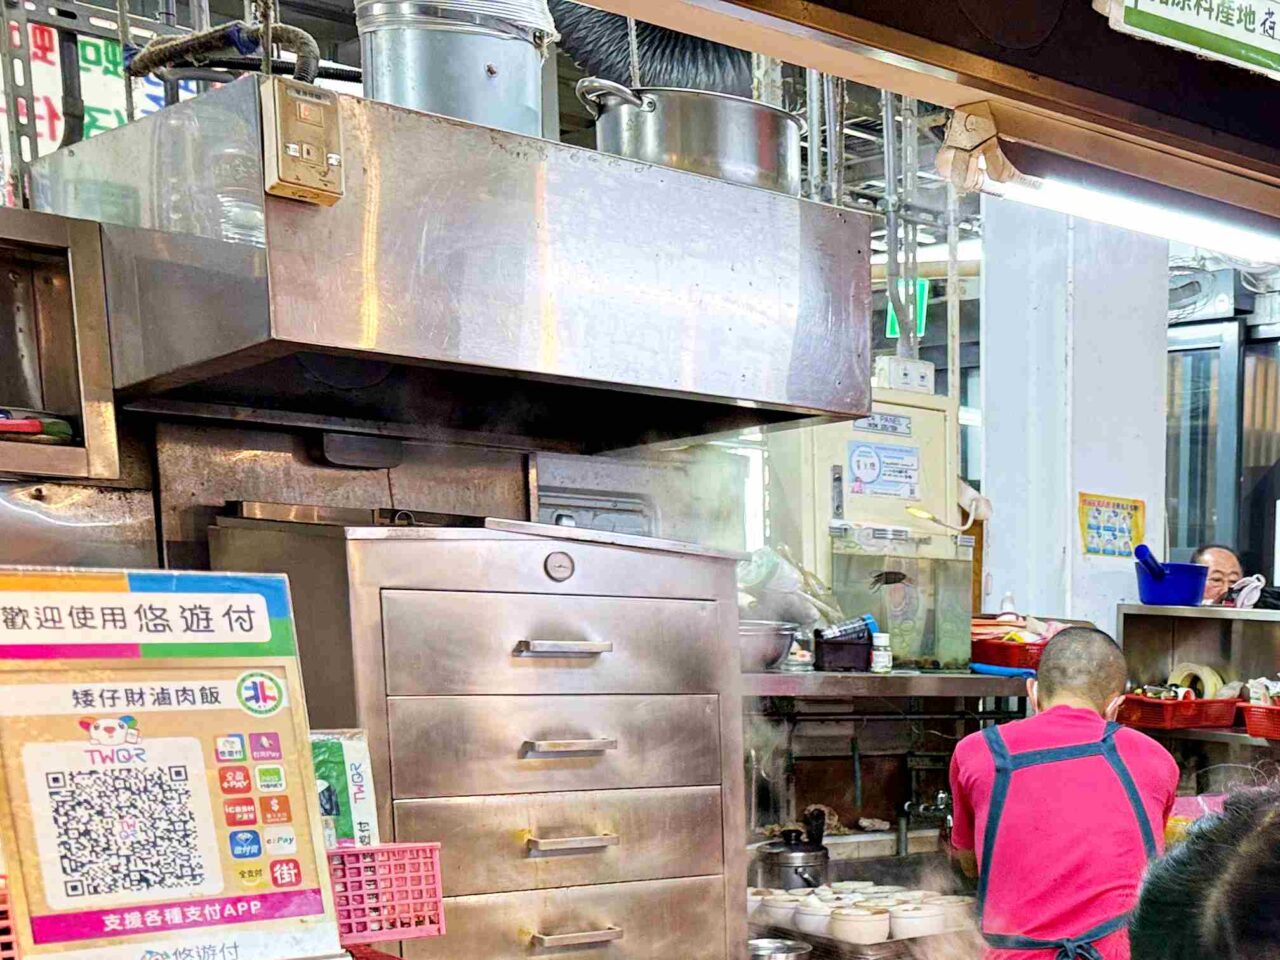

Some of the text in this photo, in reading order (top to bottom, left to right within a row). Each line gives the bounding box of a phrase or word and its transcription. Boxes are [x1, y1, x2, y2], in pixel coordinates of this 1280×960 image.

[72, 686, 222, 710] 矮仔財滷肉飯
[84, 747, 147, 765] TWQR
[102, 901, 262, 932] 支援各種支付APP
